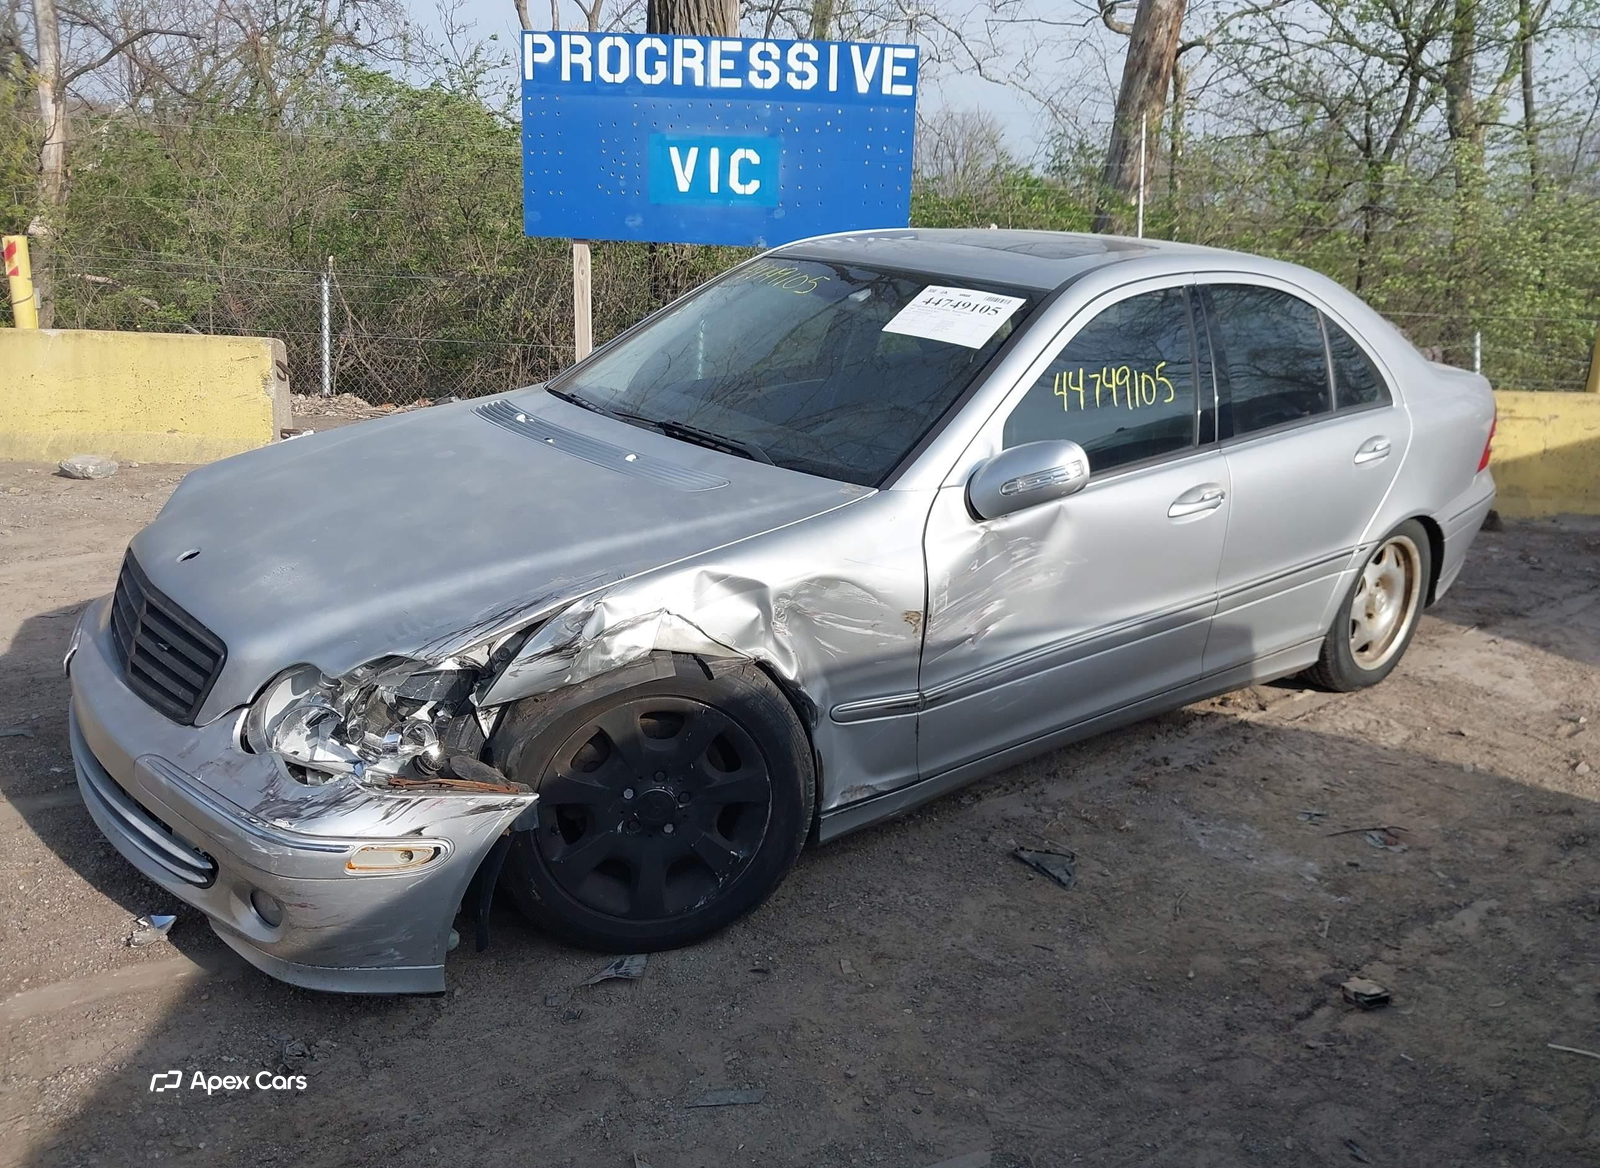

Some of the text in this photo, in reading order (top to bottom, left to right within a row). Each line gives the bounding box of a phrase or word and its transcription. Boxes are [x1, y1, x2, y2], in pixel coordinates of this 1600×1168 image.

[524, 33, 915, 96] PROGRESSIVE
[669, 146, 761, 195] VIC
[922, 296, 1003, 316] 44749105
[1053, 361, 1175, 412] 44749105
